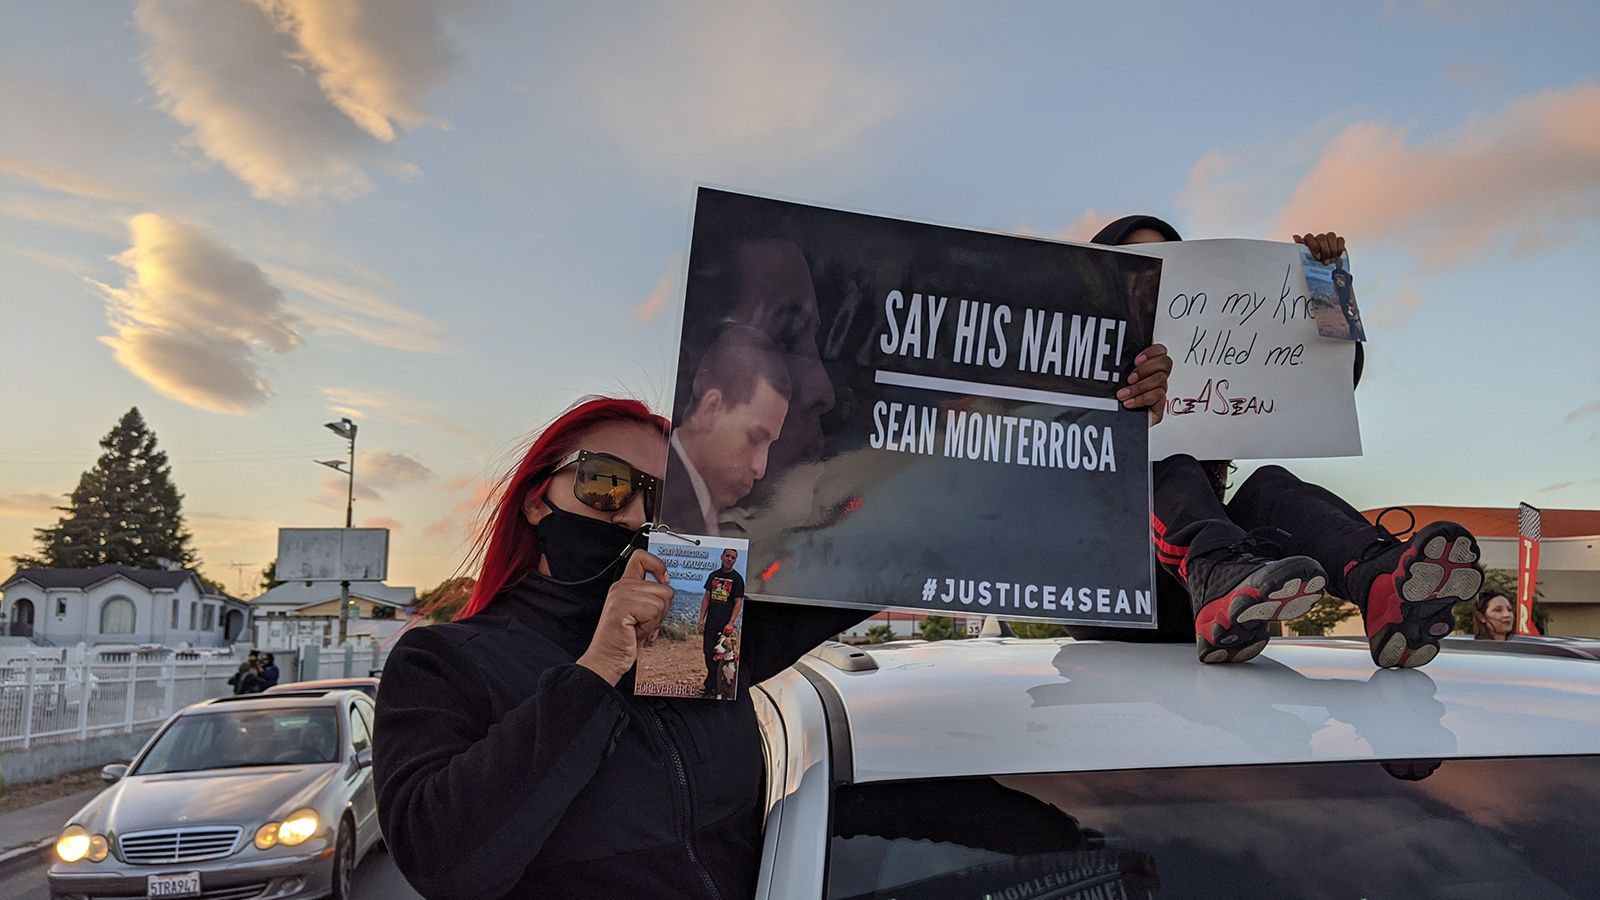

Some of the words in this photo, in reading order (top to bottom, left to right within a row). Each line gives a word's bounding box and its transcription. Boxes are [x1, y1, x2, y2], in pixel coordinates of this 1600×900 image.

[1168, 292, 1207, 319] on
[1221, 292, 1266, 326] my
[880, 289, 947, 360] SAY
[953, 299, 1012, 368] HIS
[1018, 308, 1127, 383] NAME!
[869, 400, 937, 455] SEAN
[943, 409, 1117, 472] MONTERROSA
[922, 578, 1151, 615] #JUSTICE4SEAN
[150, 879, 198, 895] 5TRA947
